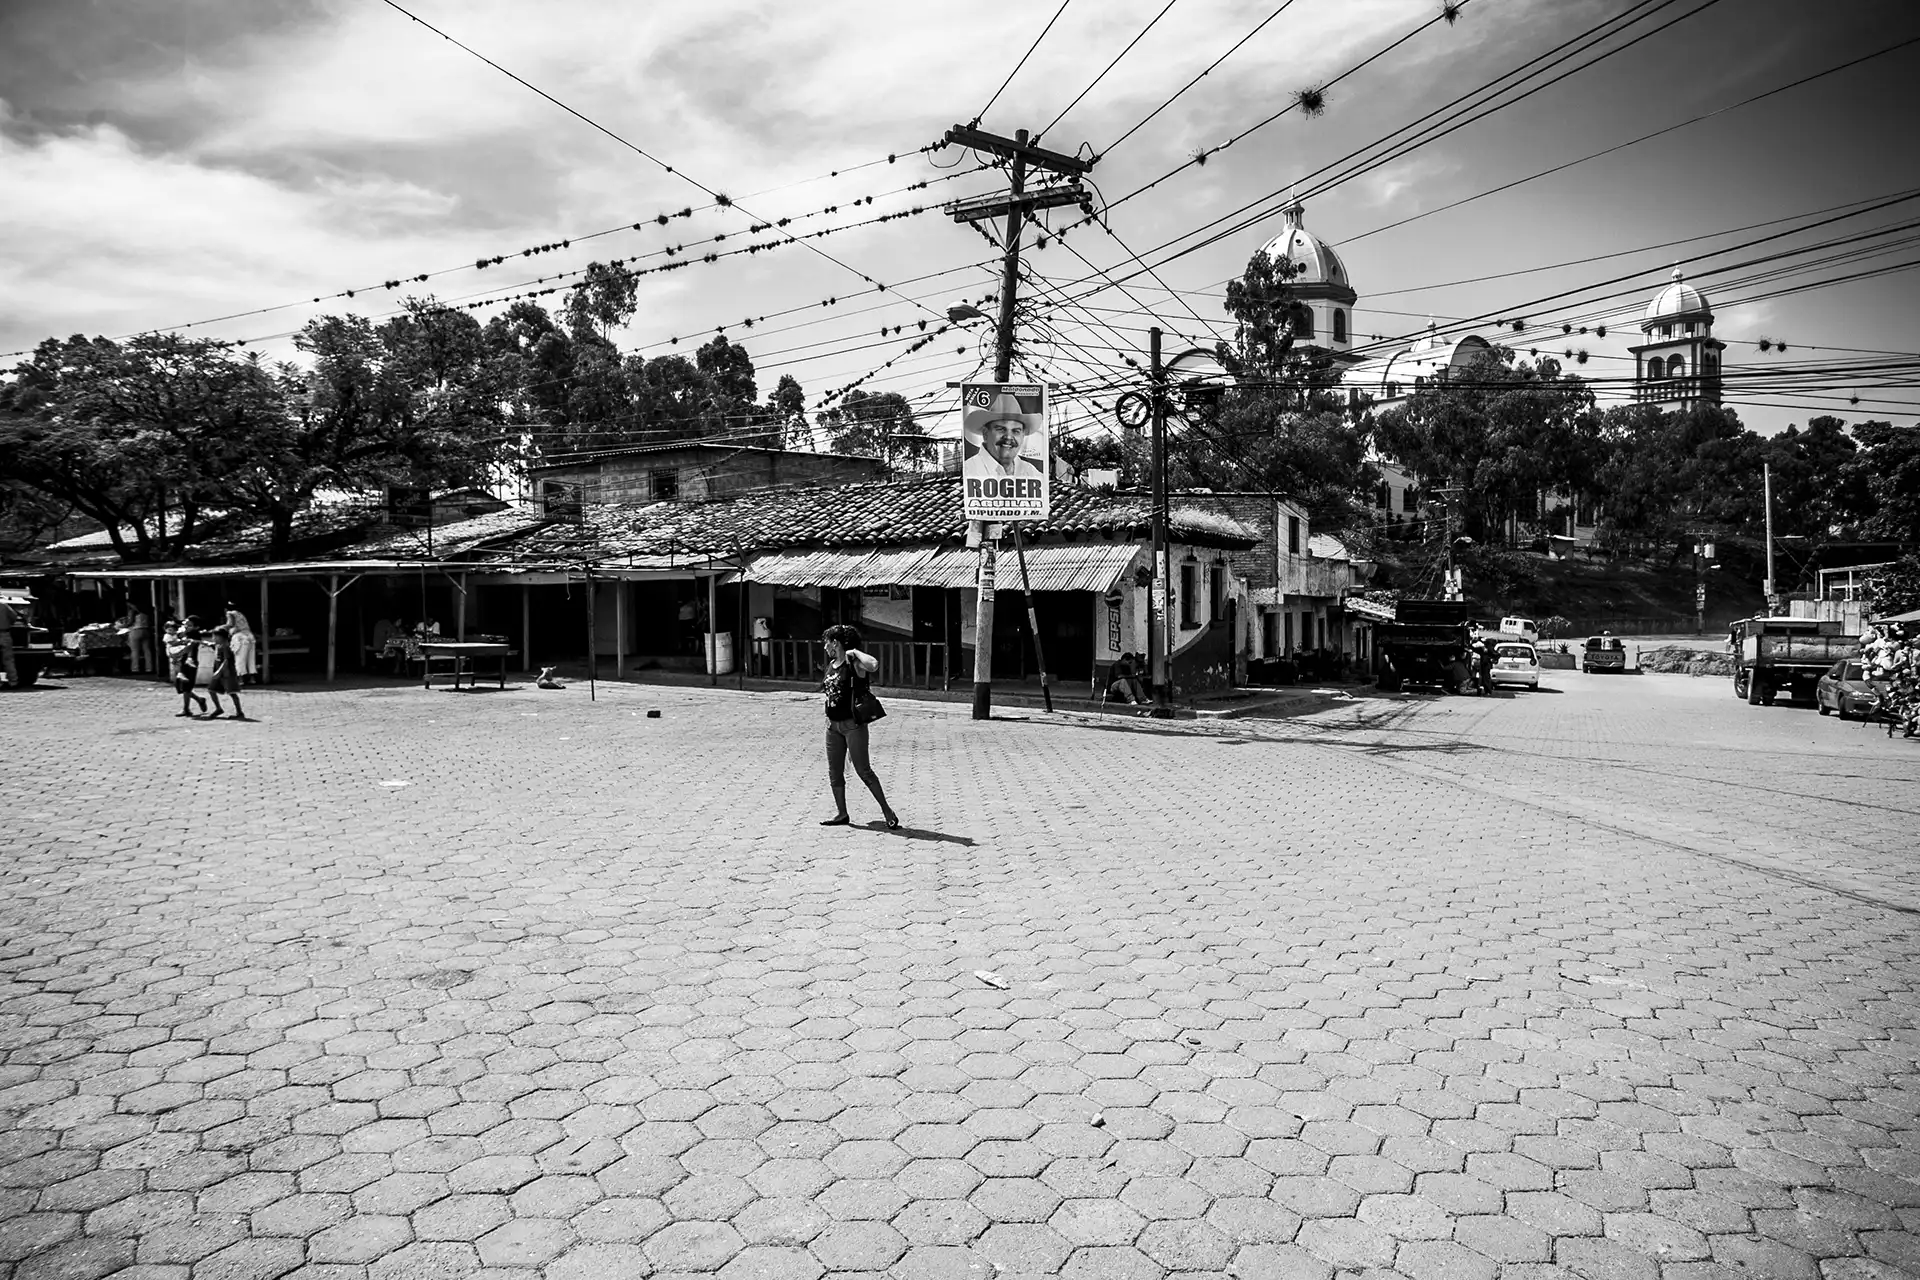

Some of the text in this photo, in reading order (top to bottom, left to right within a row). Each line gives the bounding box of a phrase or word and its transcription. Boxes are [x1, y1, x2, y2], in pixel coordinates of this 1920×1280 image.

[977, 391, 991, 407] 6
[967, 478, 1042, 498] ROGER
[968, 499, 1043, 508] AGUILAR
[1109, 607, 1121, 652] PEPSI
